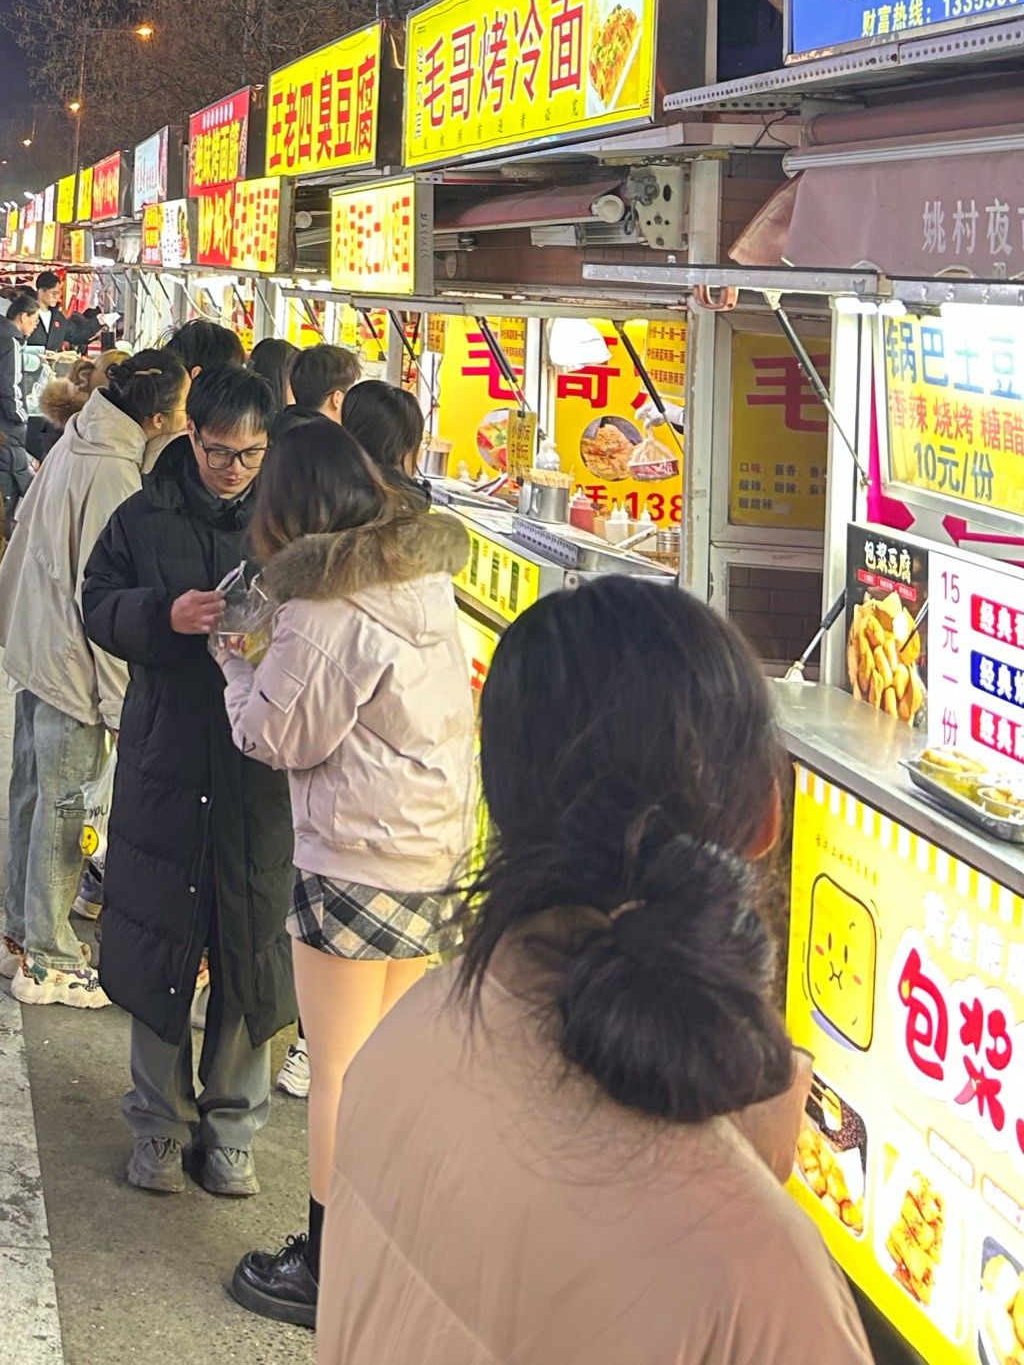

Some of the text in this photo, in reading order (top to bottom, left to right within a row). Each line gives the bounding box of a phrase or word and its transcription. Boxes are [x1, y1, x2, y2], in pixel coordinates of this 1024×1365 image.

[268, 53, 377, 168] 王老四臭豆腐
[885, 319, 1023, 402] 锅巴土豆
[932, 401, 975, 447] 烧烤
[913, 441, 996, 502] 10元/份
[863, 539, 912, 586] 包浆豆腐
[898, 947, 1024, 1154] 包浆
